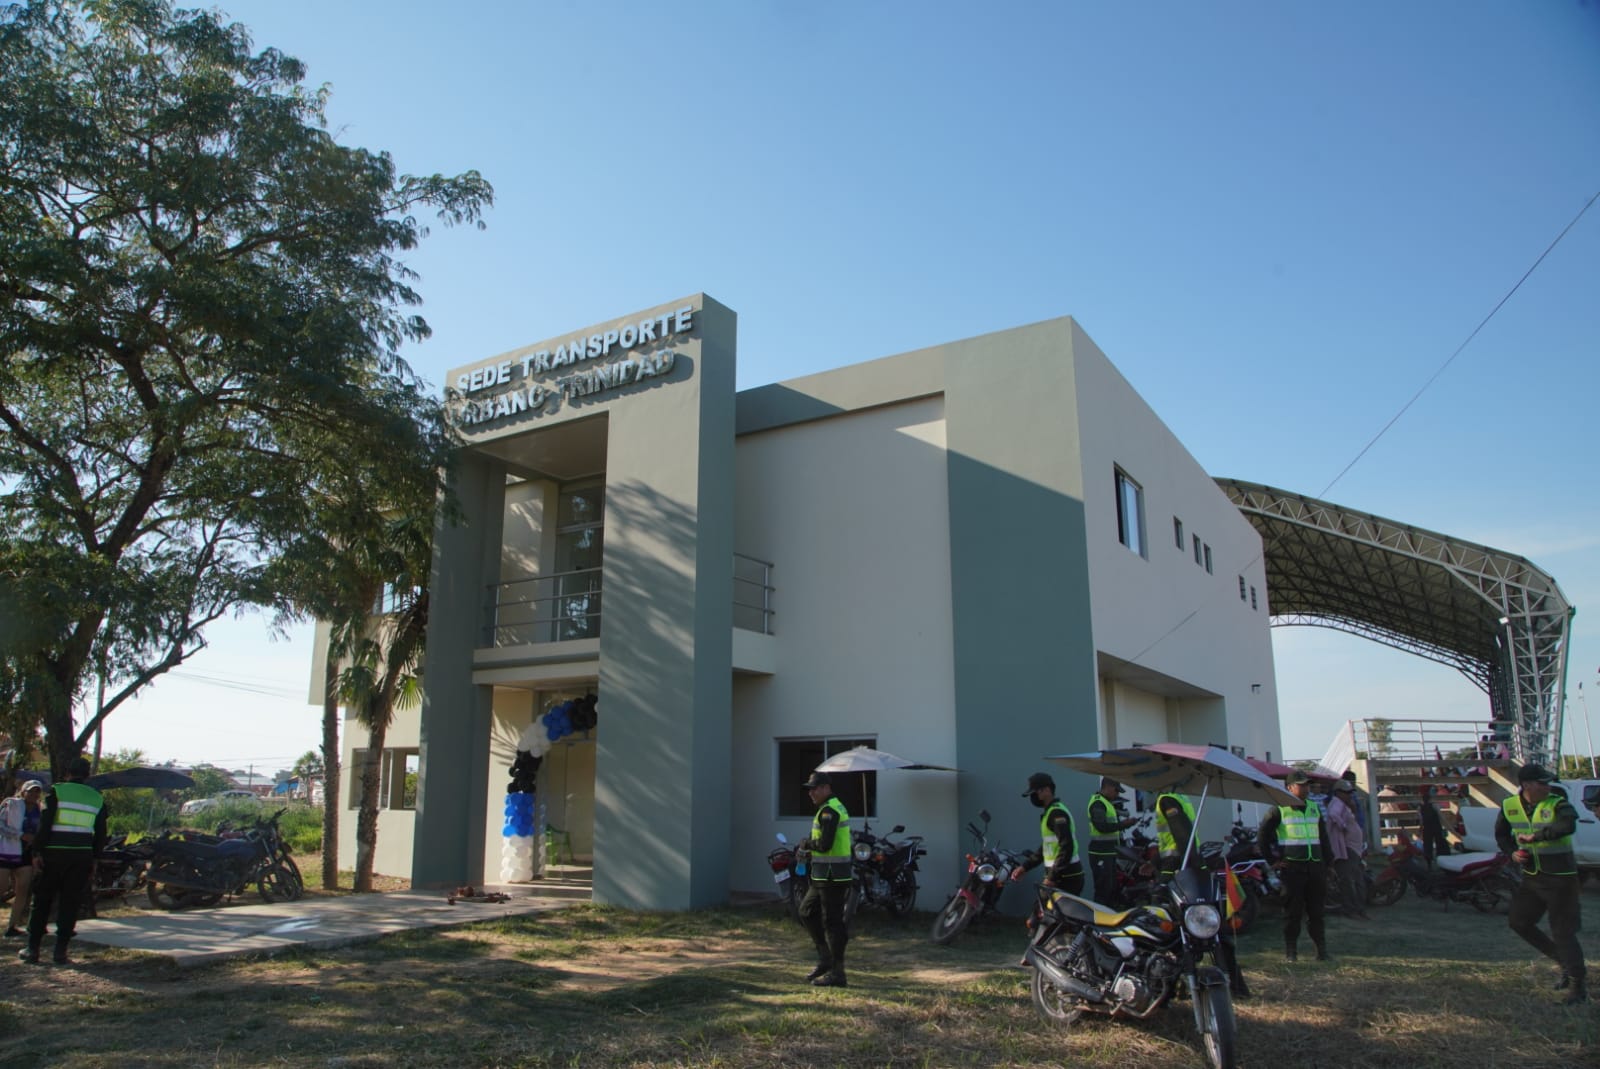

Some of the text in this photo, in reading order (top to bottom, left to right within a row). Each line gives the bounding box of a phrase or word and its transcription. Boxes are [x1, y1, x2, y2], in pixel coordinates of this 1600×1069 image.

[456, 305, 693, 394] SEDE TRANSPORTE
[555, 348, 674, 400] TRINIDAD
